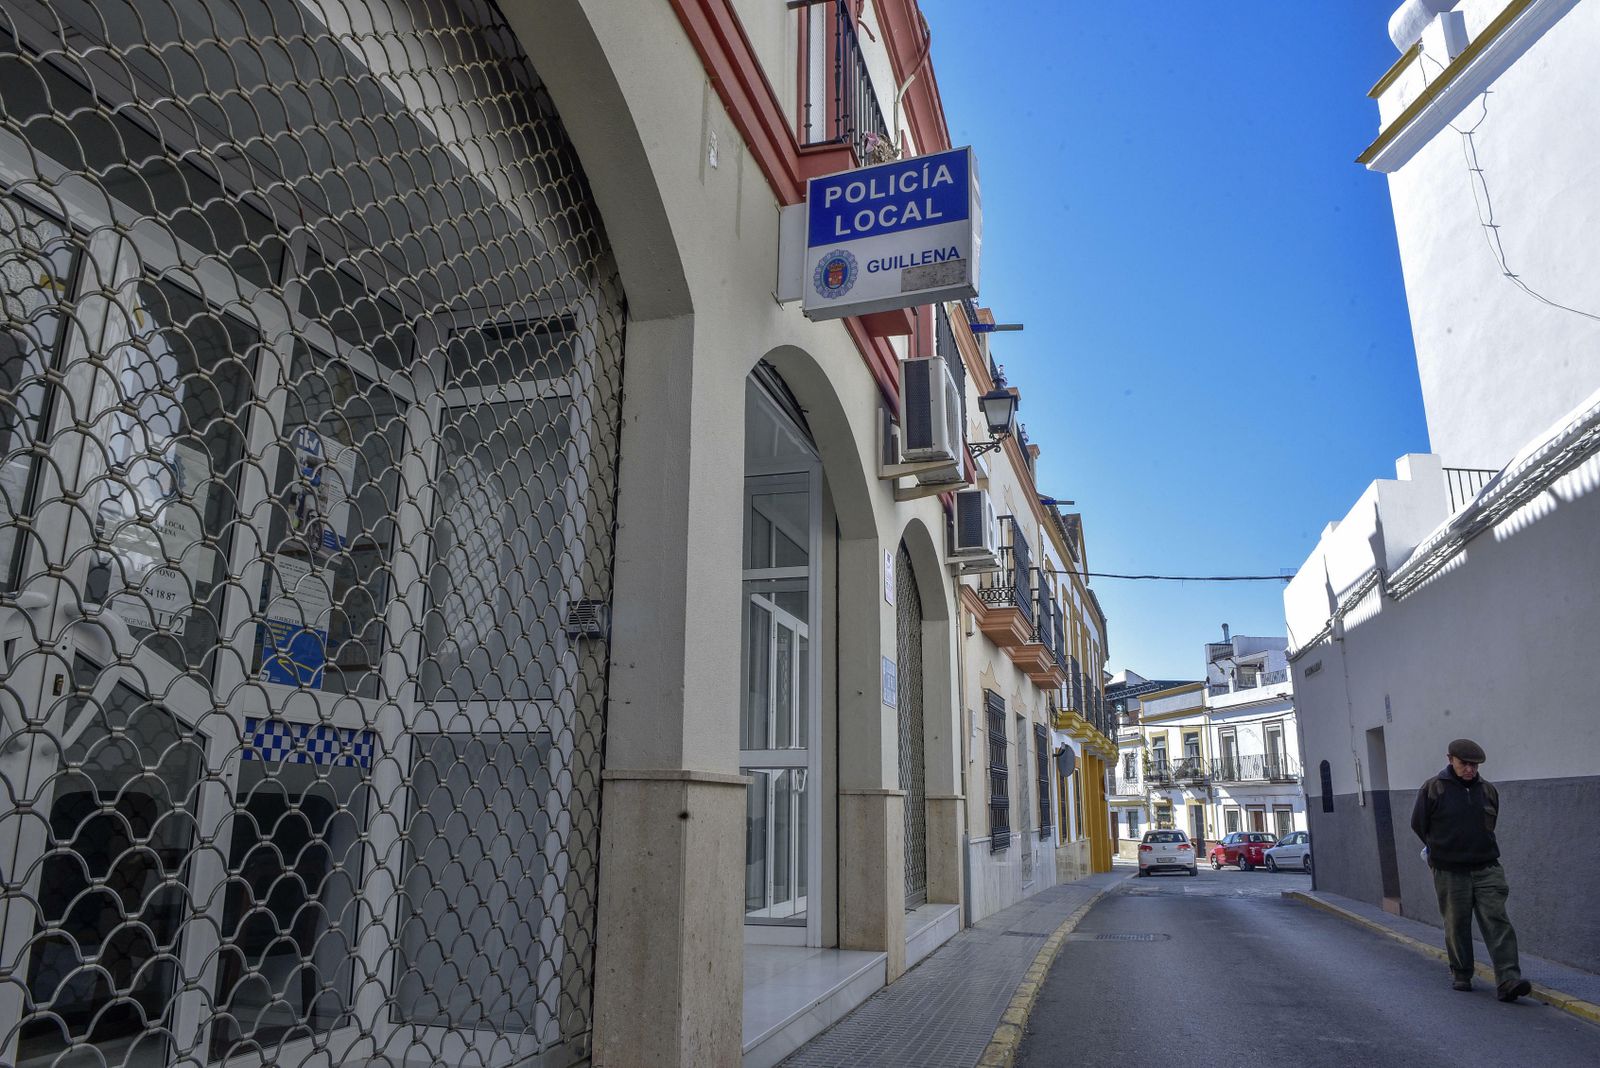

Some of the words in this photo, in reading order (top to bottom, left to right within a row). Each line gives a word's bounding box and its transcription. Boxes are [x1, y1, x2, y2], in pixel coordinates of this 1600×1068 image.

[825, 162, 954, 208] POLICÍA
[835, 197, 943, 236] LOCAL
[866, 246, 960, 274] GUILLENA
[298, 428, 319, 451] itv
